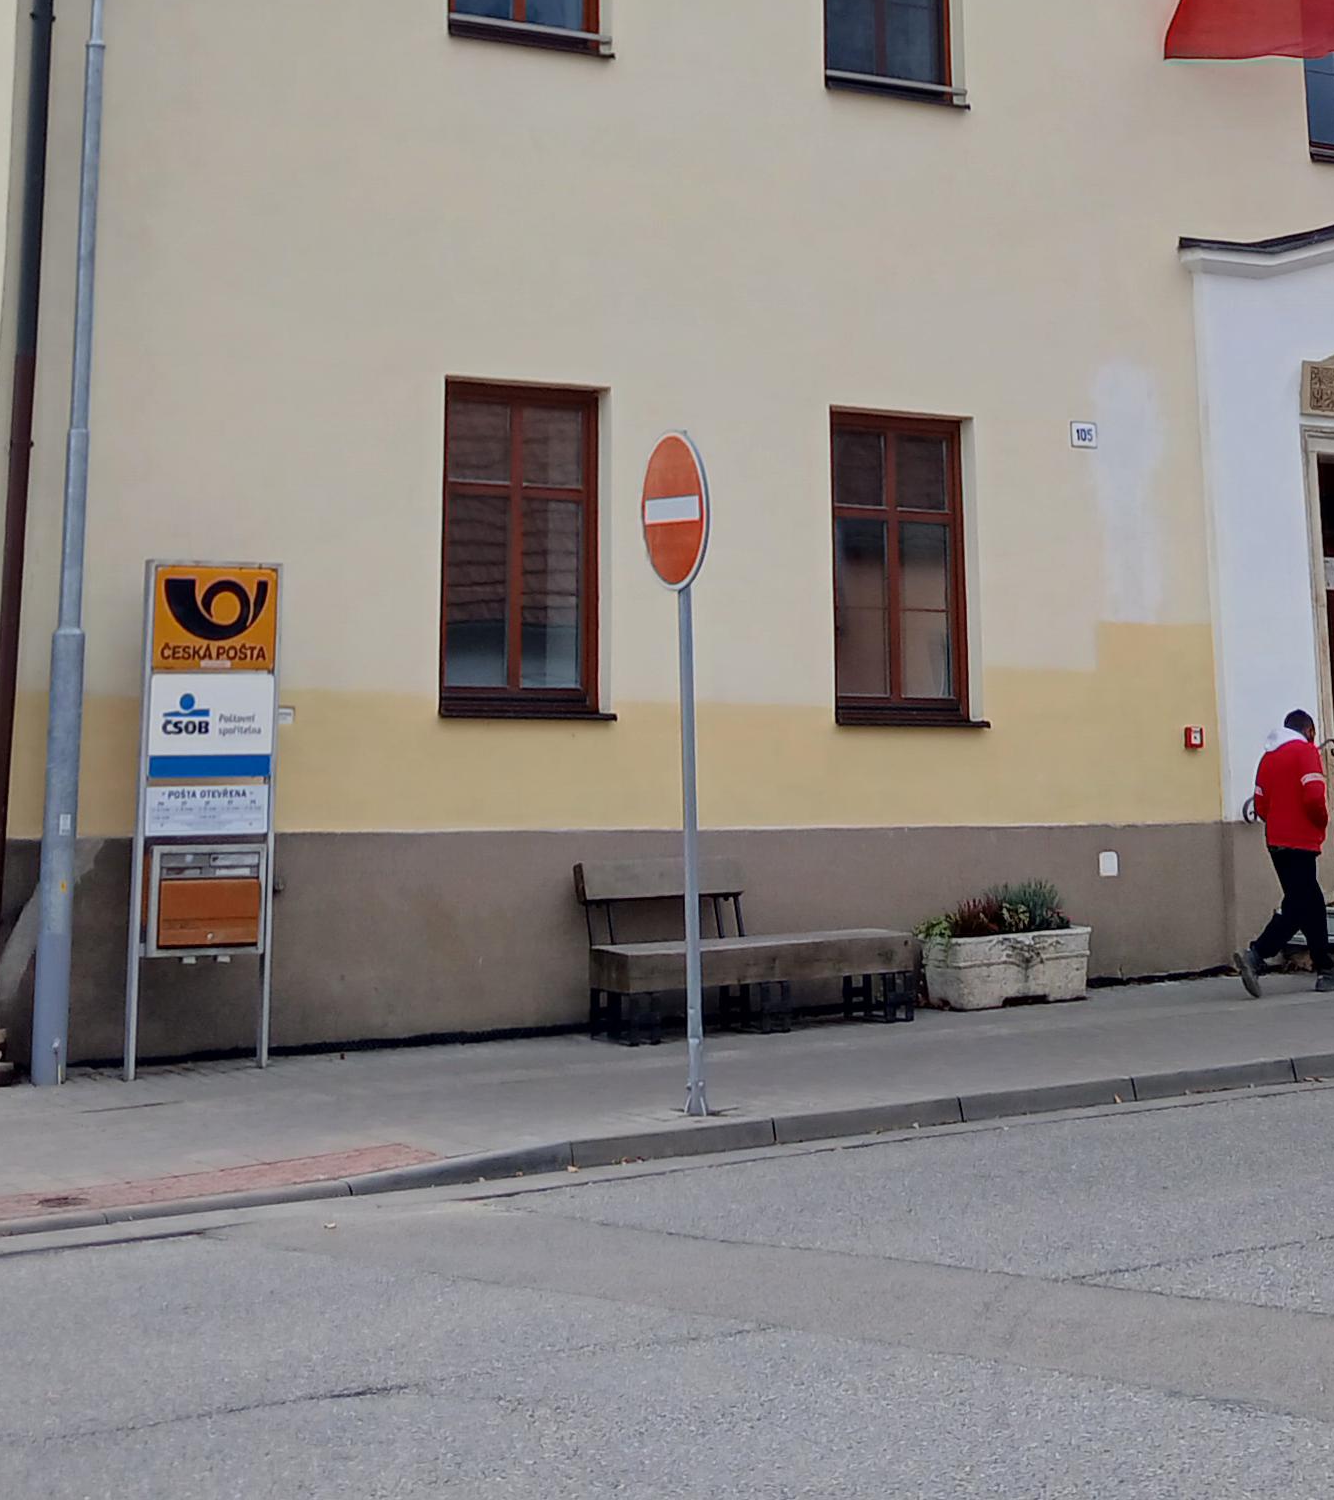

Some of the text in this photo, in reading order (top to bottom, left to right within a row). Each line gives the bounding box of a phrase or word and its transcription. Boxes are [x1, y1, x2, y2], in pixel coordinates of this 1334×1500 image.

[1076, 428, 1093, 442] 105
[160, 643, 266, 660] ČESKÁ POŠTA
[162, 719, 210, 735] ČSOB
[168, 788, 197, 799] POŠTA
